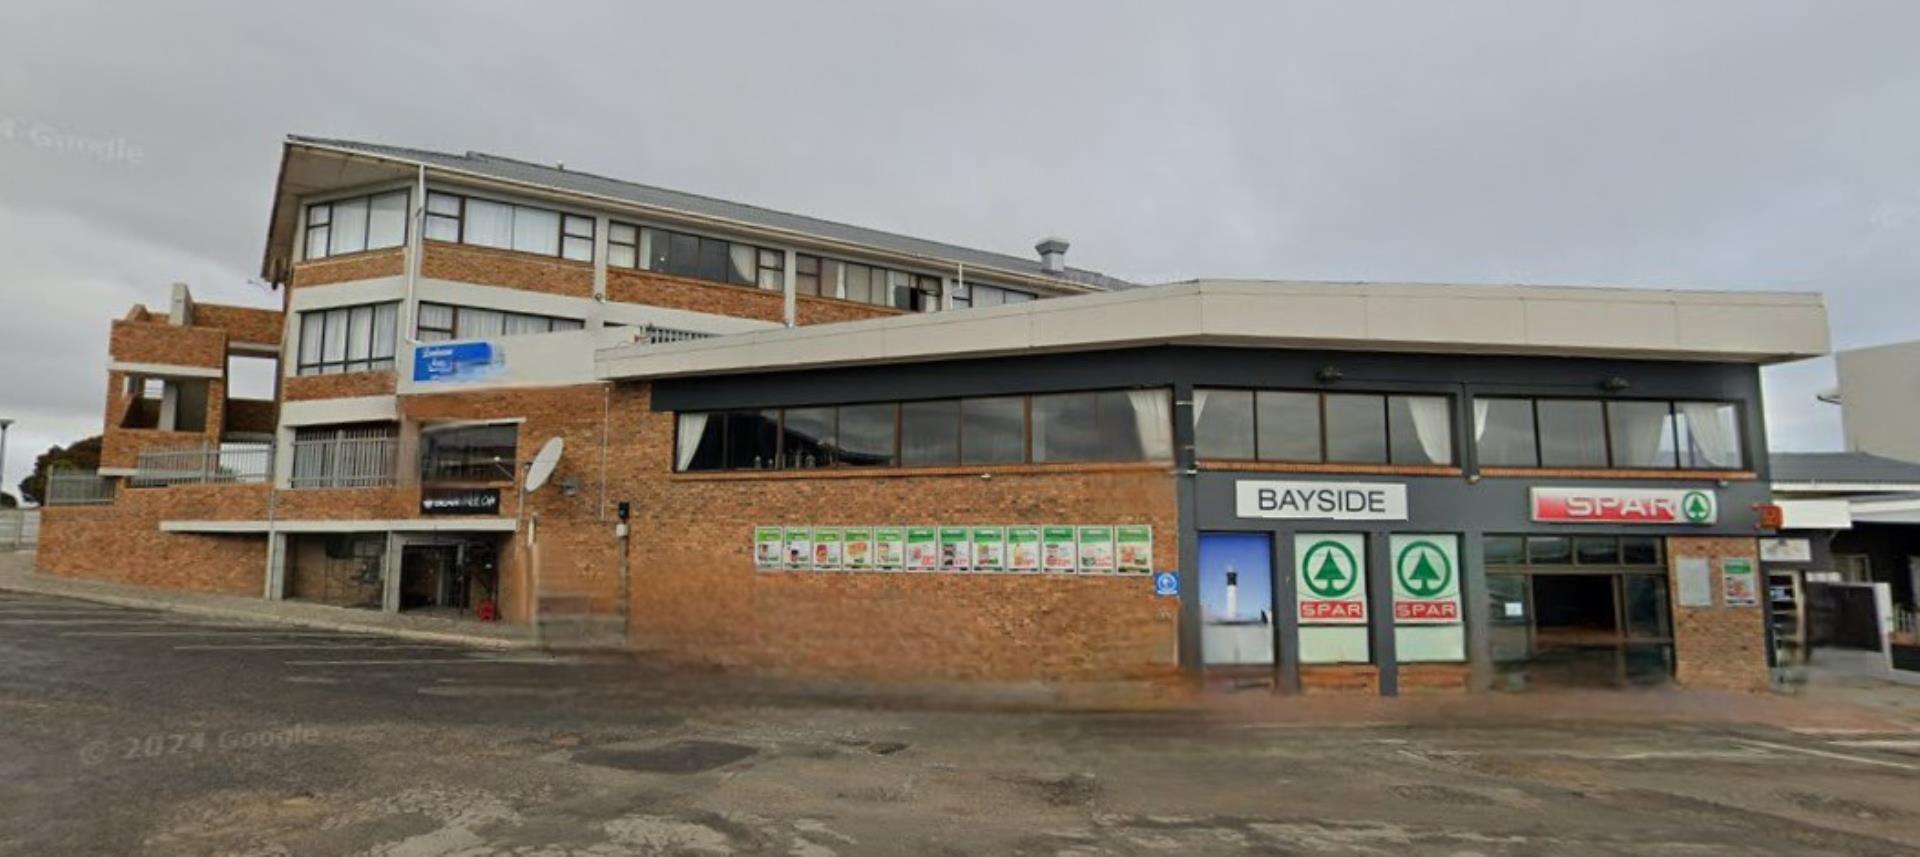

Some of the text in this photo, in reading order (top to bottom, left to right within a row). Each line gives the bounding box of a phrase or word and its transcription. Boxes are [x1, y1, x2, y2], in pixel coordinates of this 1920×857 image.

[1258, 488, 1386, 513] BAYSIDE
[1566, 496, 1675, 518] SPAR
[1302, 603, 1362, 617] SPAR
[1396, 603, 1456, 617] SPAR
